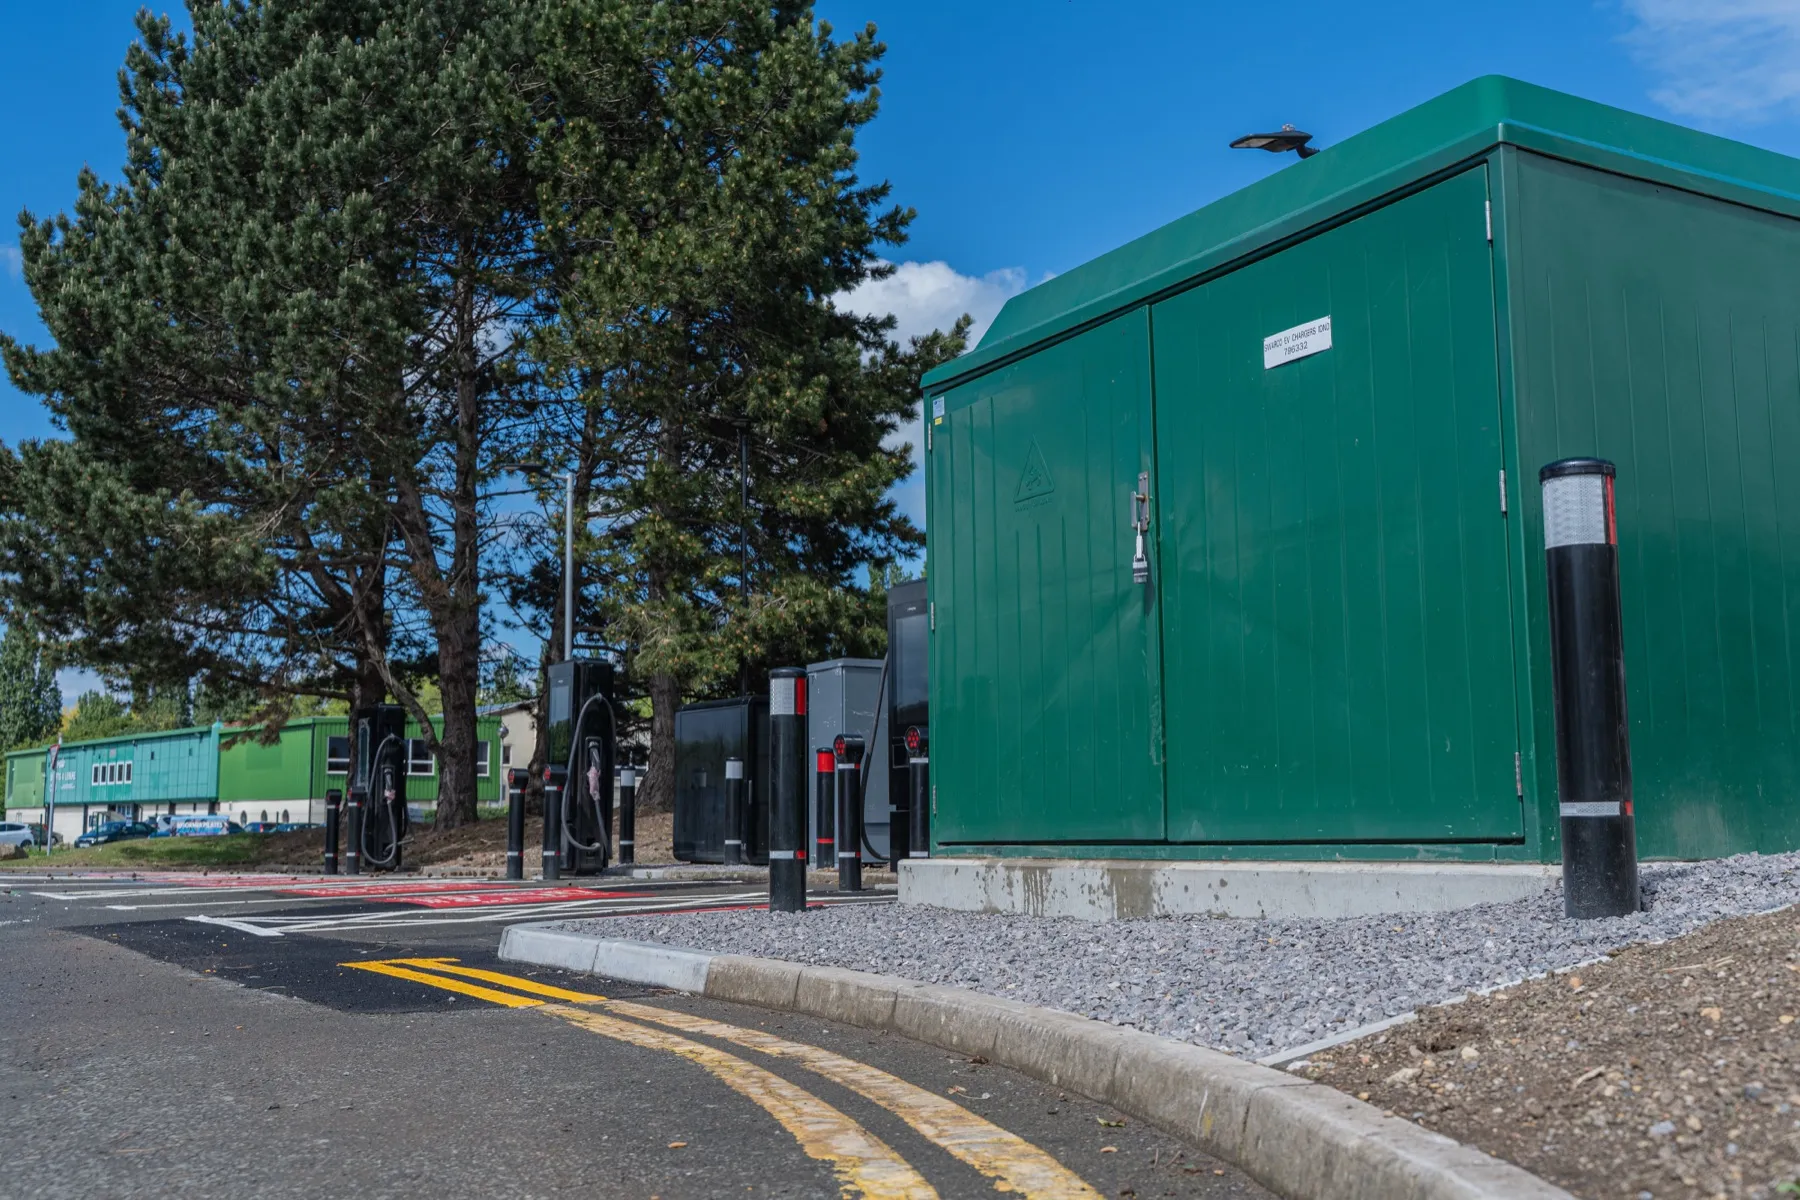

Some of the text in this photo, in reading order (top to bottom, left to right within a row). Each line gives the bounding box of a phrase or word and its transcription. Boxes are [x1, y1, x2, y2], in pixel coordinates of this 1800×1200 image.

[1264, 338, 1282, 352] SWARCO
[1284, 336, 1290, 344] EV
[1292, 327, 1316, 341] CHARGERS
